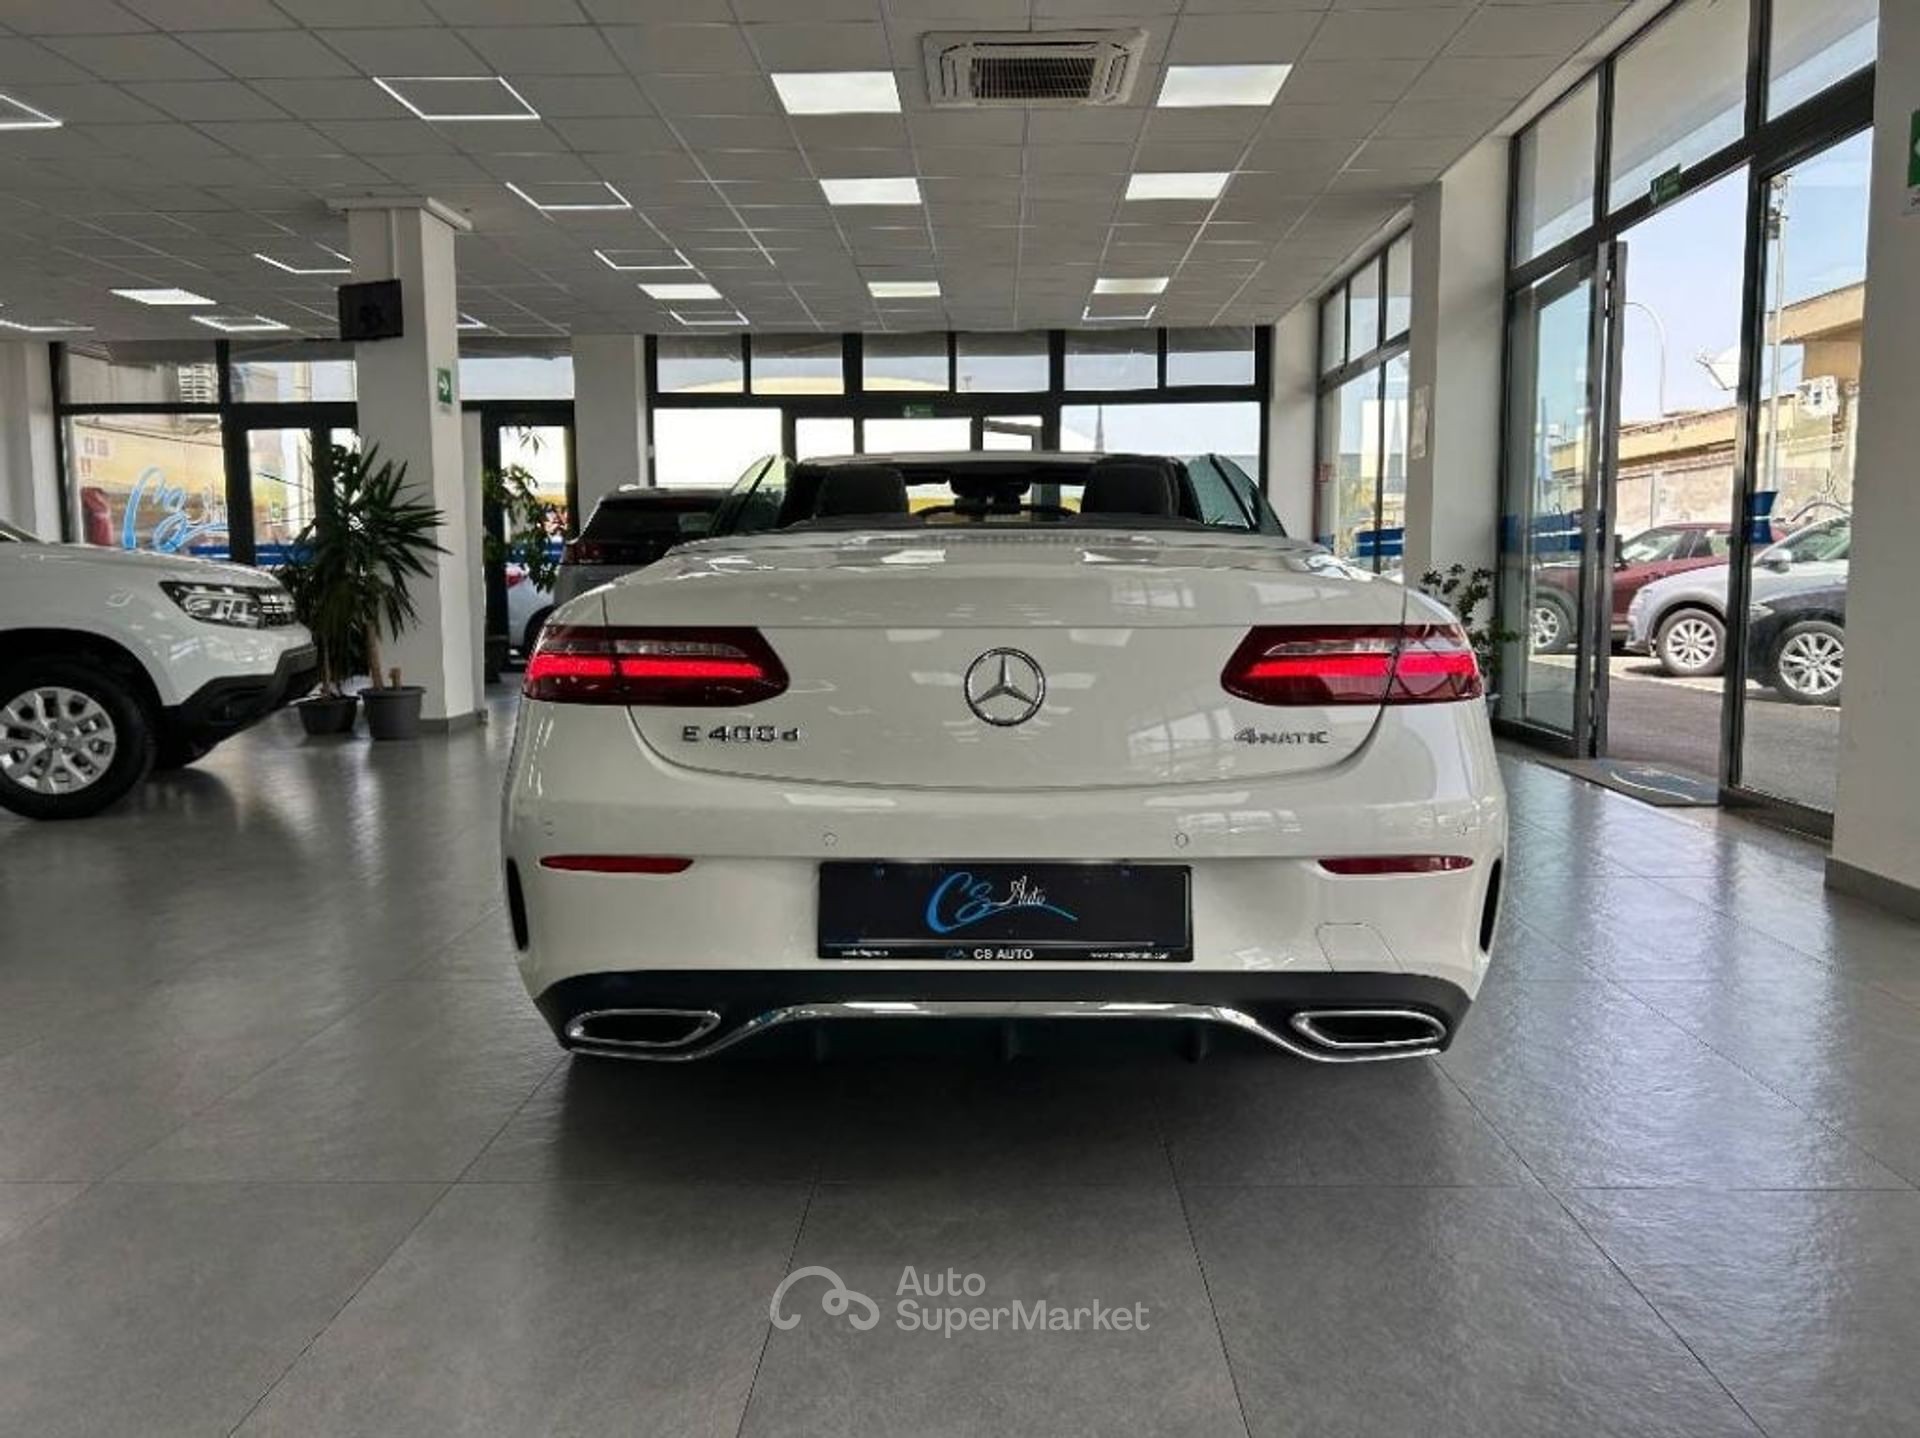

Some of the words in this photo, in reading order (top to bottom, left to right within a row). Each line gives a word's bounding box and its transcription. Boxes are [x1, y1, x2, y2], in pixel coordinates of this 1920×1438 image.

[683, 726, 701, 742] E
[973, 948, 993, 960] CS
[996, 948, 1034, 960] AUTO
